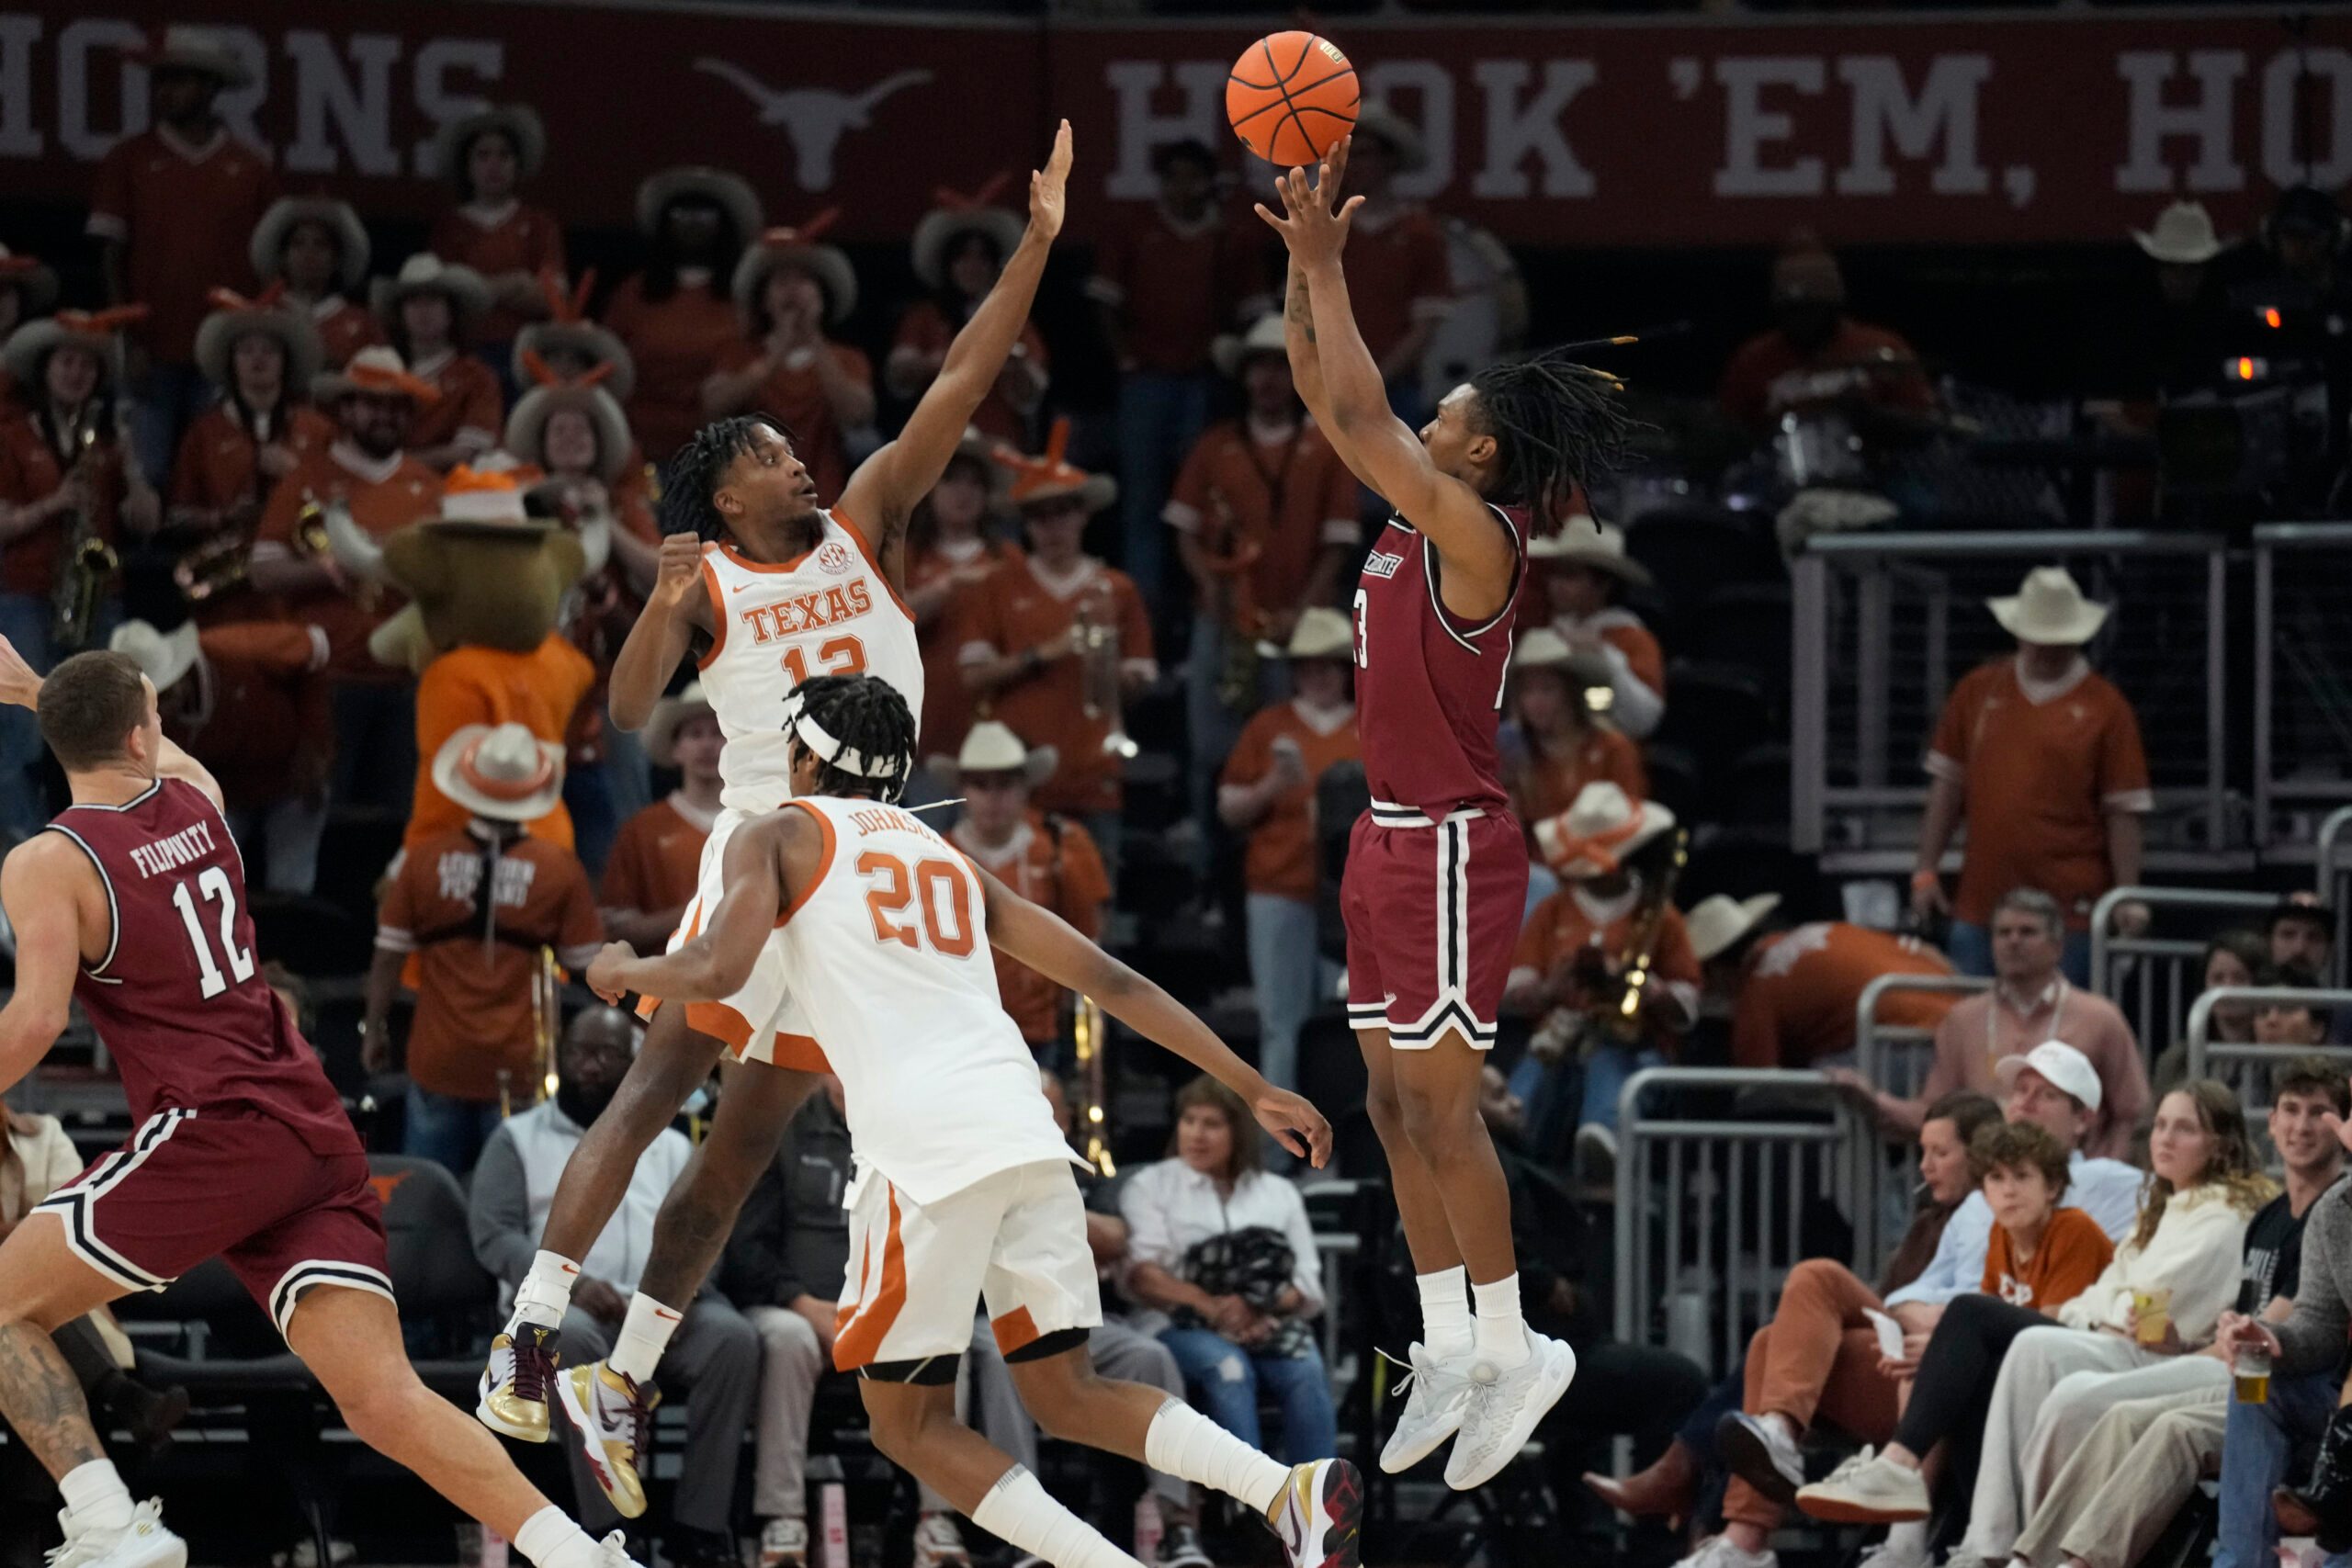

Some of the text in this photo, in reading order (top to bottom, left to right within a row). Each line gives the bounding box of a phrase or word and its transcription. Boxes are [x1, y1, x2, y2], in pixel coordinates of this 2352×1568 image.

[1107, 59, 1597, 198] HOK
[1668, 53, 2037, 209] 'EM,
[741, 576, 874, 645] TEXAS
[820, 543, 846, 568] SEC
[173, 865, 254, 999] 12
[854, 849, 977, 961] 20
